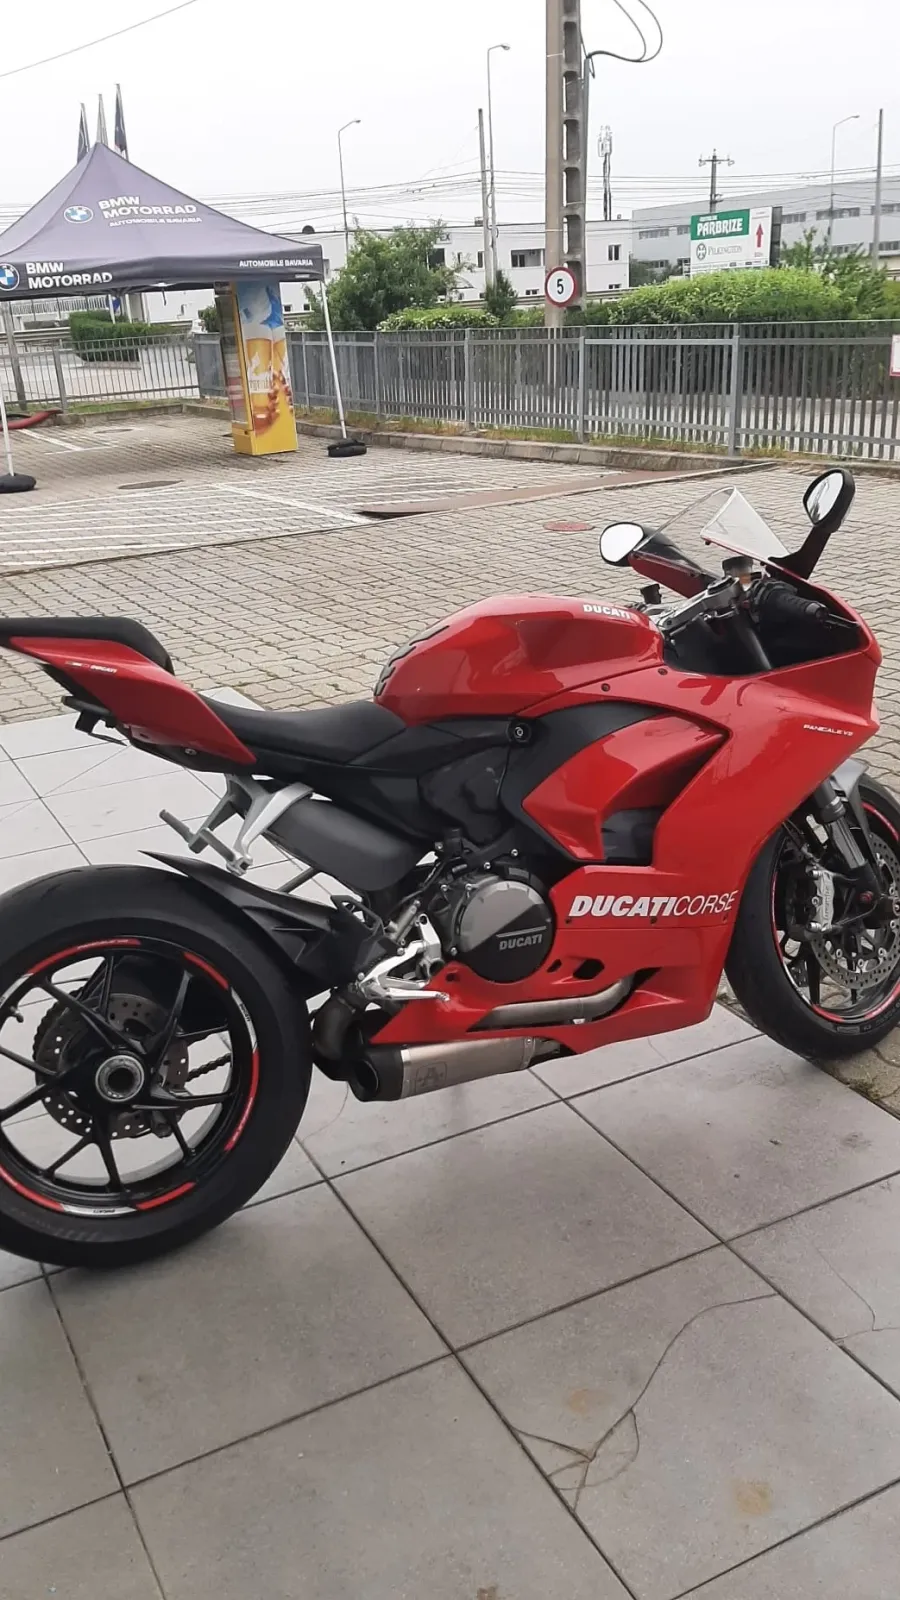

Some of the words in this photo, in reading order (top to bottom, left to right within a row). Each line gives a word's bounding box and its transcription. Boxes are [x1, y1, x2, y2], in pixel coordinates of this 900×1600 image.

[99, 196, 140, 209] BMW
[103, 205, 197, 219] MOTORRAD
[110, 219, 165, 227] AUTOMOBILE
[696, 218, 743, 236] PARBRIZE
[25, 262, 64, 274] BMW
[285, 259, 313, 267] BAVARIA
[28, 272, 113, 289] MOTORRAD
[556, 278, 564, 295] 5
[583, 604, 631, 619] DUCATI
[499, 933, 543, 951] DUCATI
